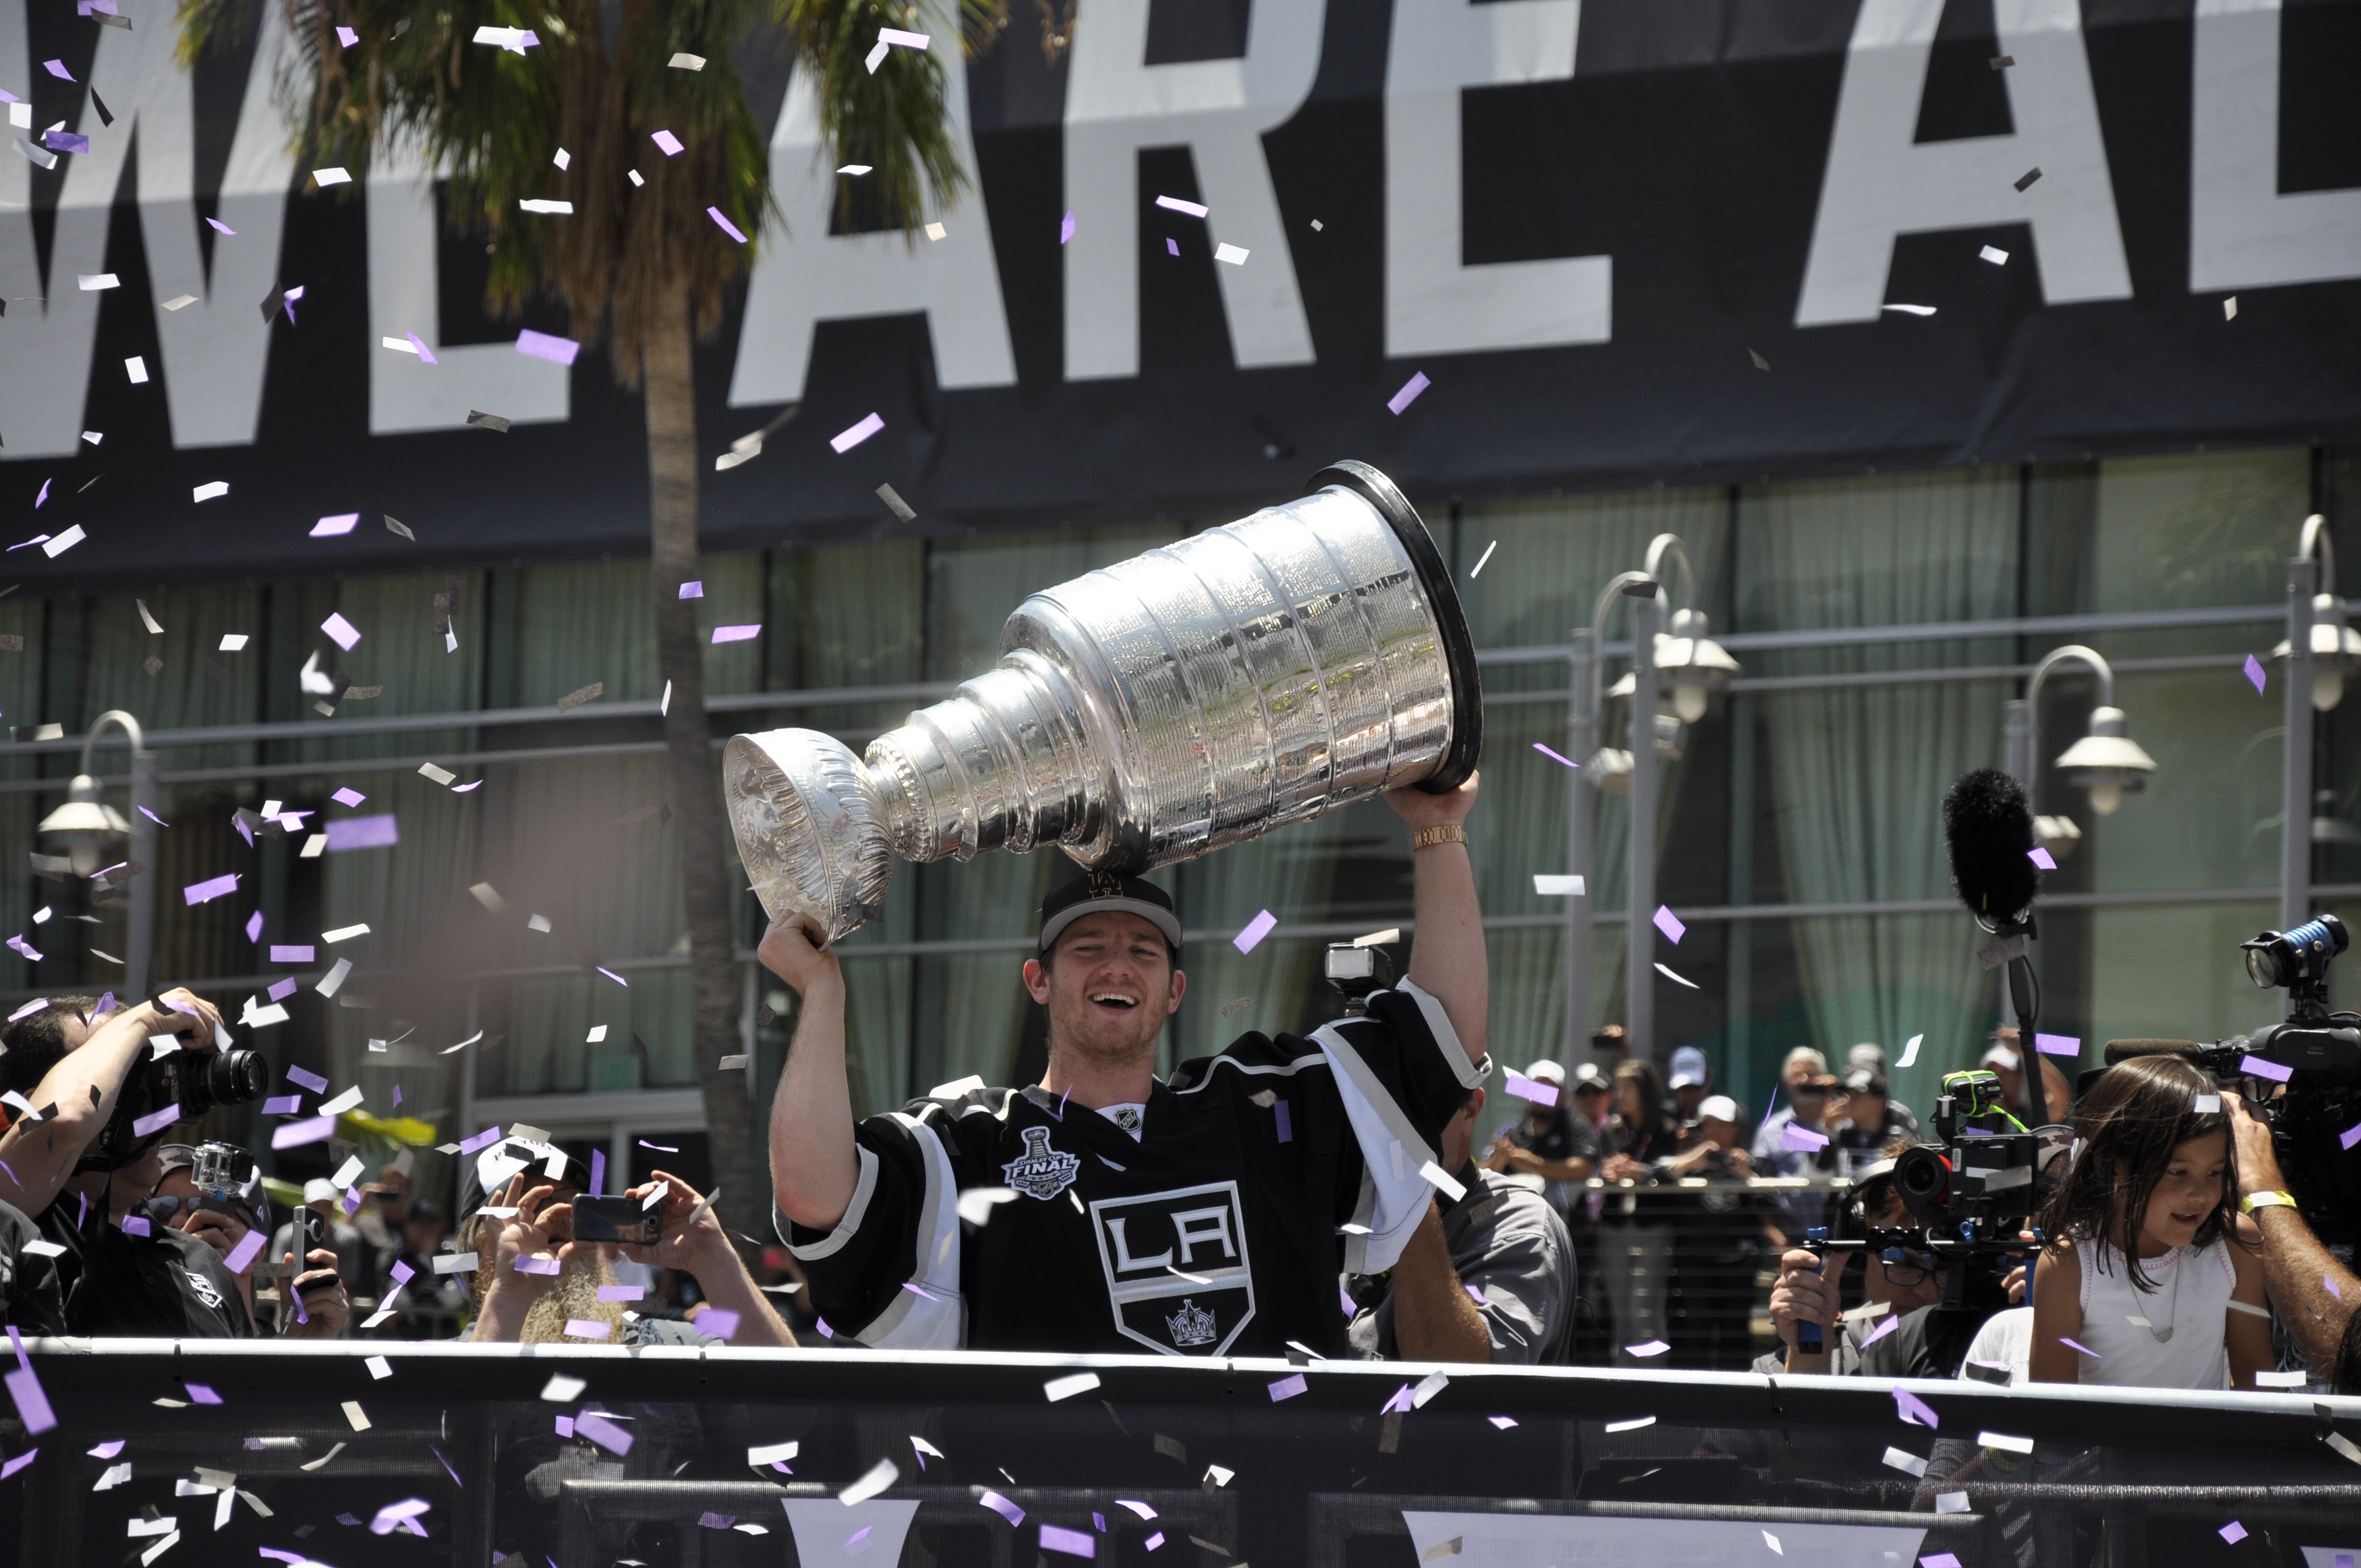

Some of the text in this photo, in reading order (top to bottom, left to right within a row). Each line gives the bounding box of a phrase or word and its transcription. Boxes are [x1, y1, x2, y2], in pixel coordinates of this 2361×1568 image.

[727, 0, 1613, 409] ARE
[1122, 1113, 1136, 1129] NHL
[1013, 1159, 1072, 1178] FINAL
[1019, 1157, 1047, 1166] STANLEY
[1106, 1205, 1236, 1273] LA
